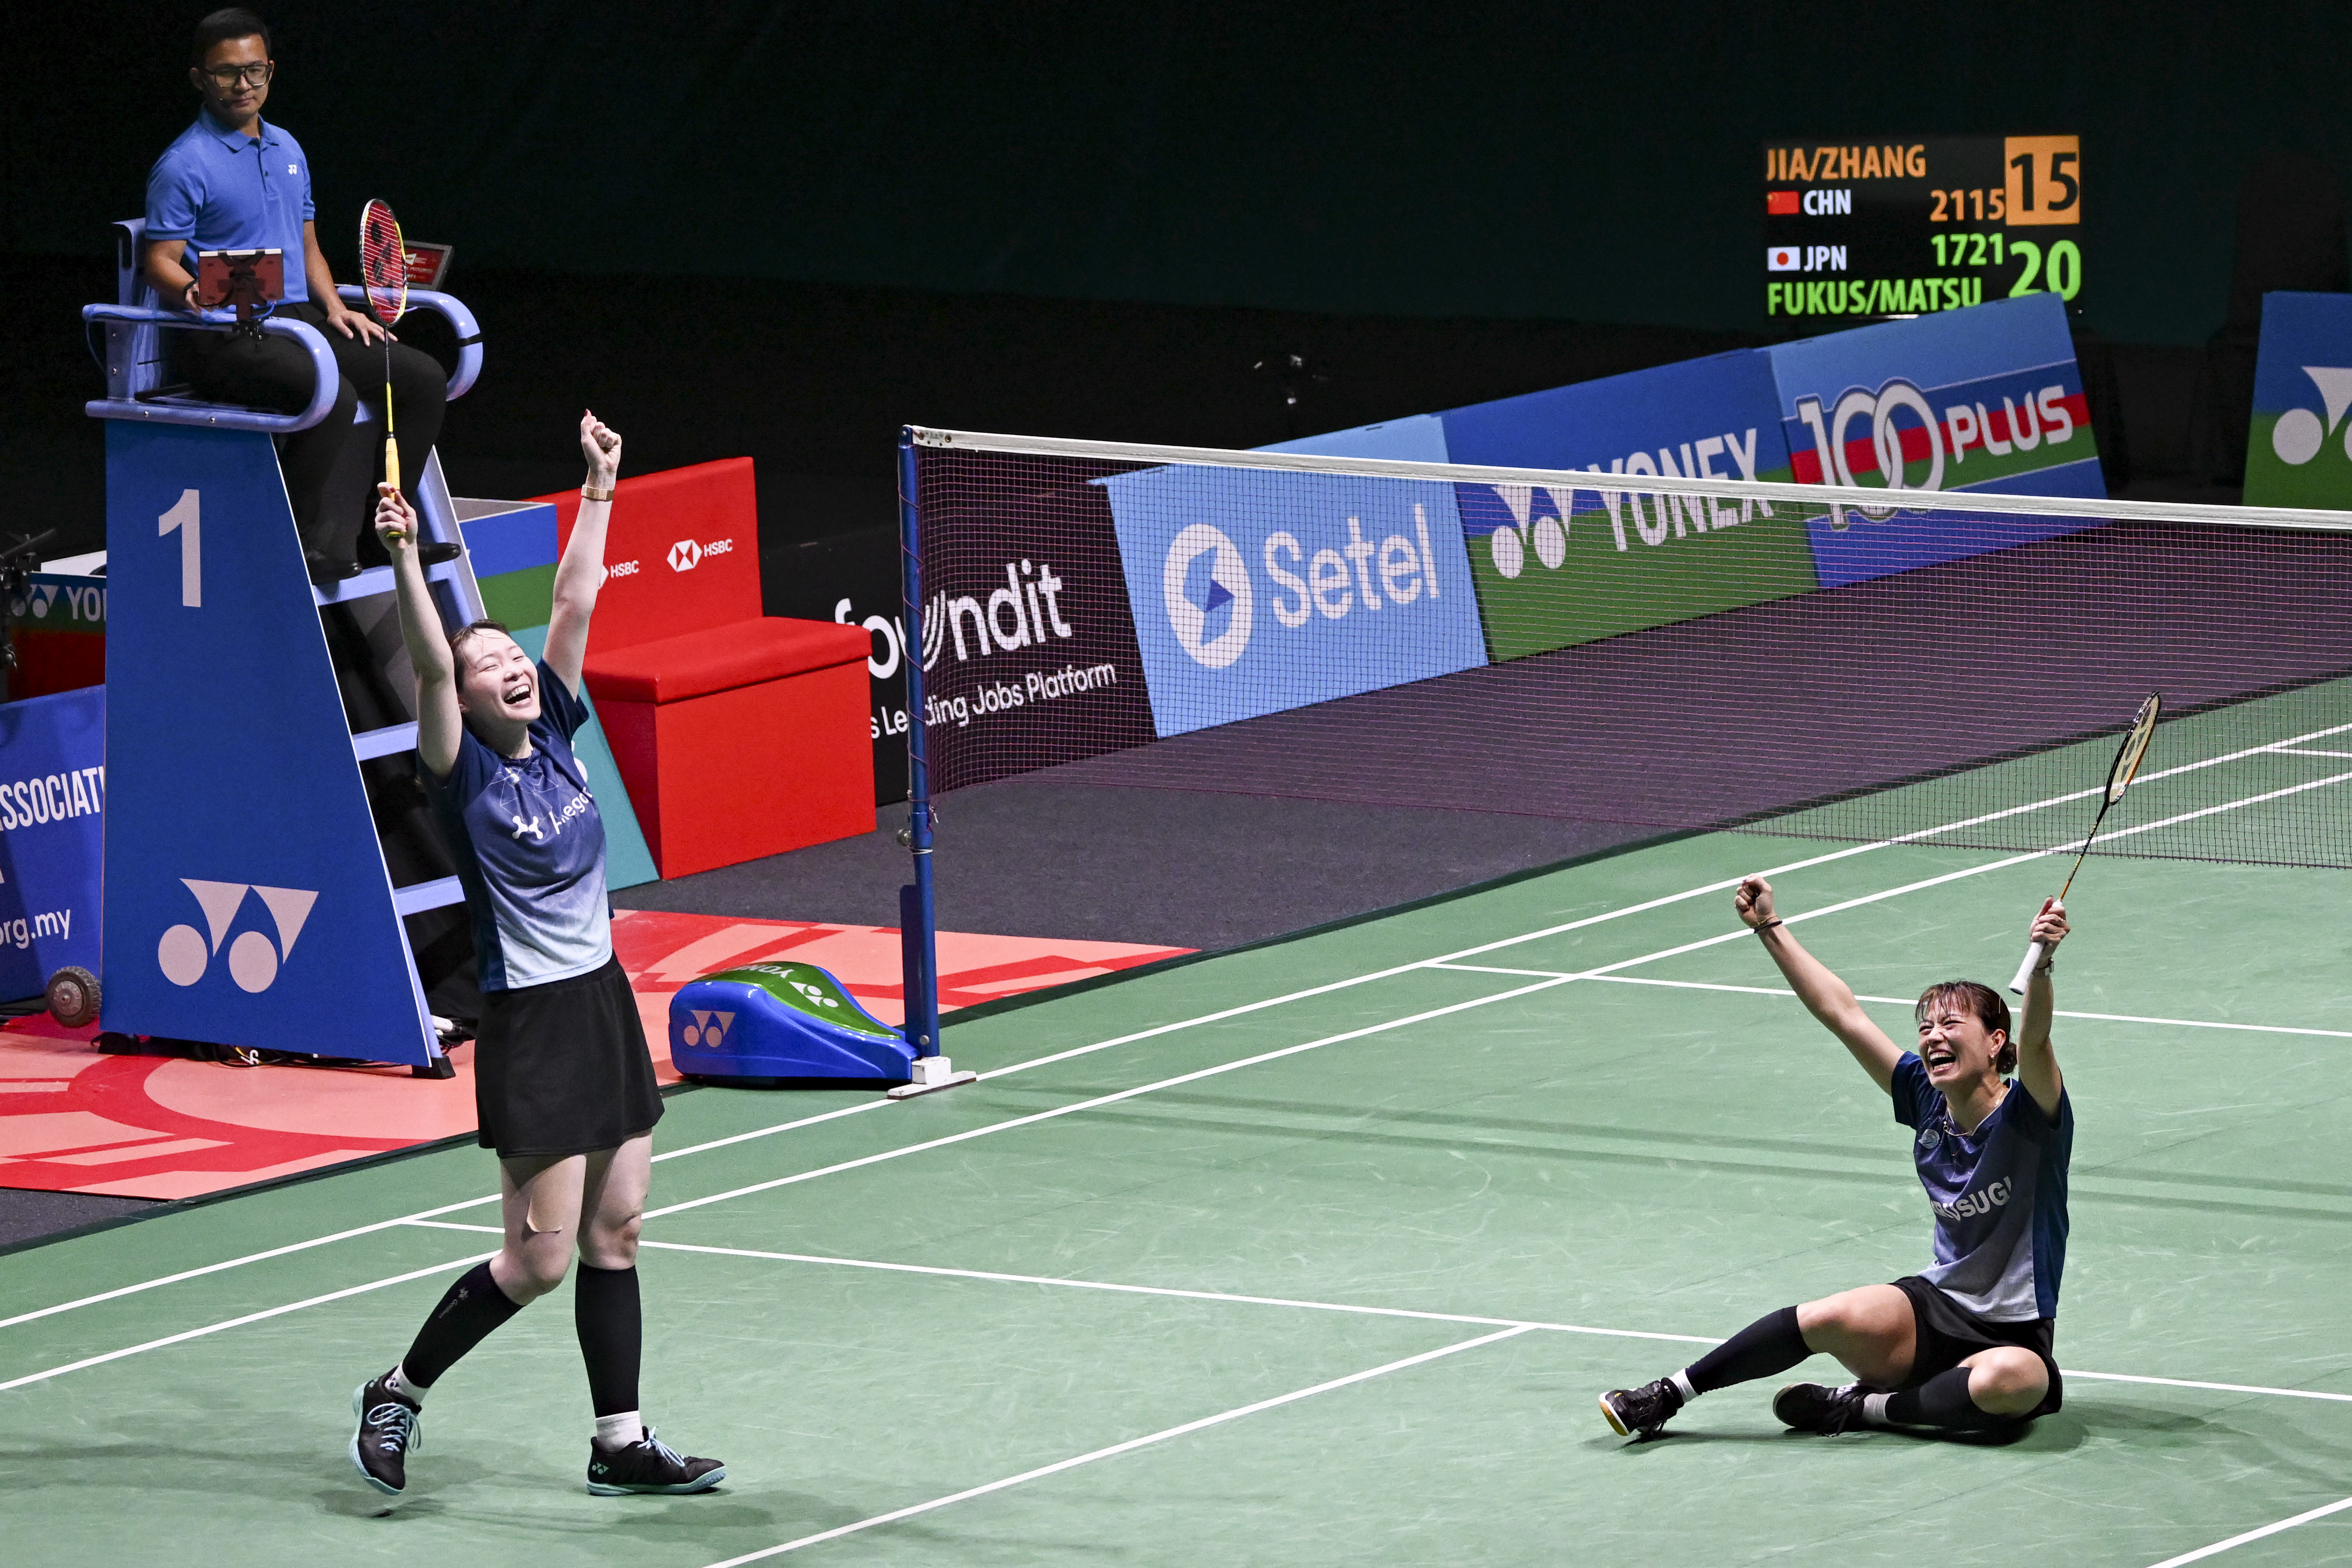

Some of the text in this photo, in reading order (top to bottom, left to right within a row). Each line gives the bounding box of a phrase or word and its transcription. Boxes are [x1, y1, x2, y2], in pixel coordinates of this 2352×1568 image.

[1767, 145, 2080, 212] JIA/ZHANG 15
[1803, 189, 1851, 216] CHN
[1768, 277, 1982, 316] FUKUS/MATSU
[1803, 245, 1847, 271] JPN
[2008, 239, 2082, 302] 20
[1797, 383, 2073, 527] 100 PLUS
[1587, 428, 1774, 552] YONEX
[158, 488, 201, 608] 1
[610, 560, 640, 578] HSBC
[704, 539, 733, 557] HSBC
[1264, 503, 1440, 628] Setel
[881, 694, 969, 728] Leding
[972, 681, 1024, 715] Jobs
[1025, 663, 1117, 703] Platform
[0, 766, 105, 832] SSOCIAT
